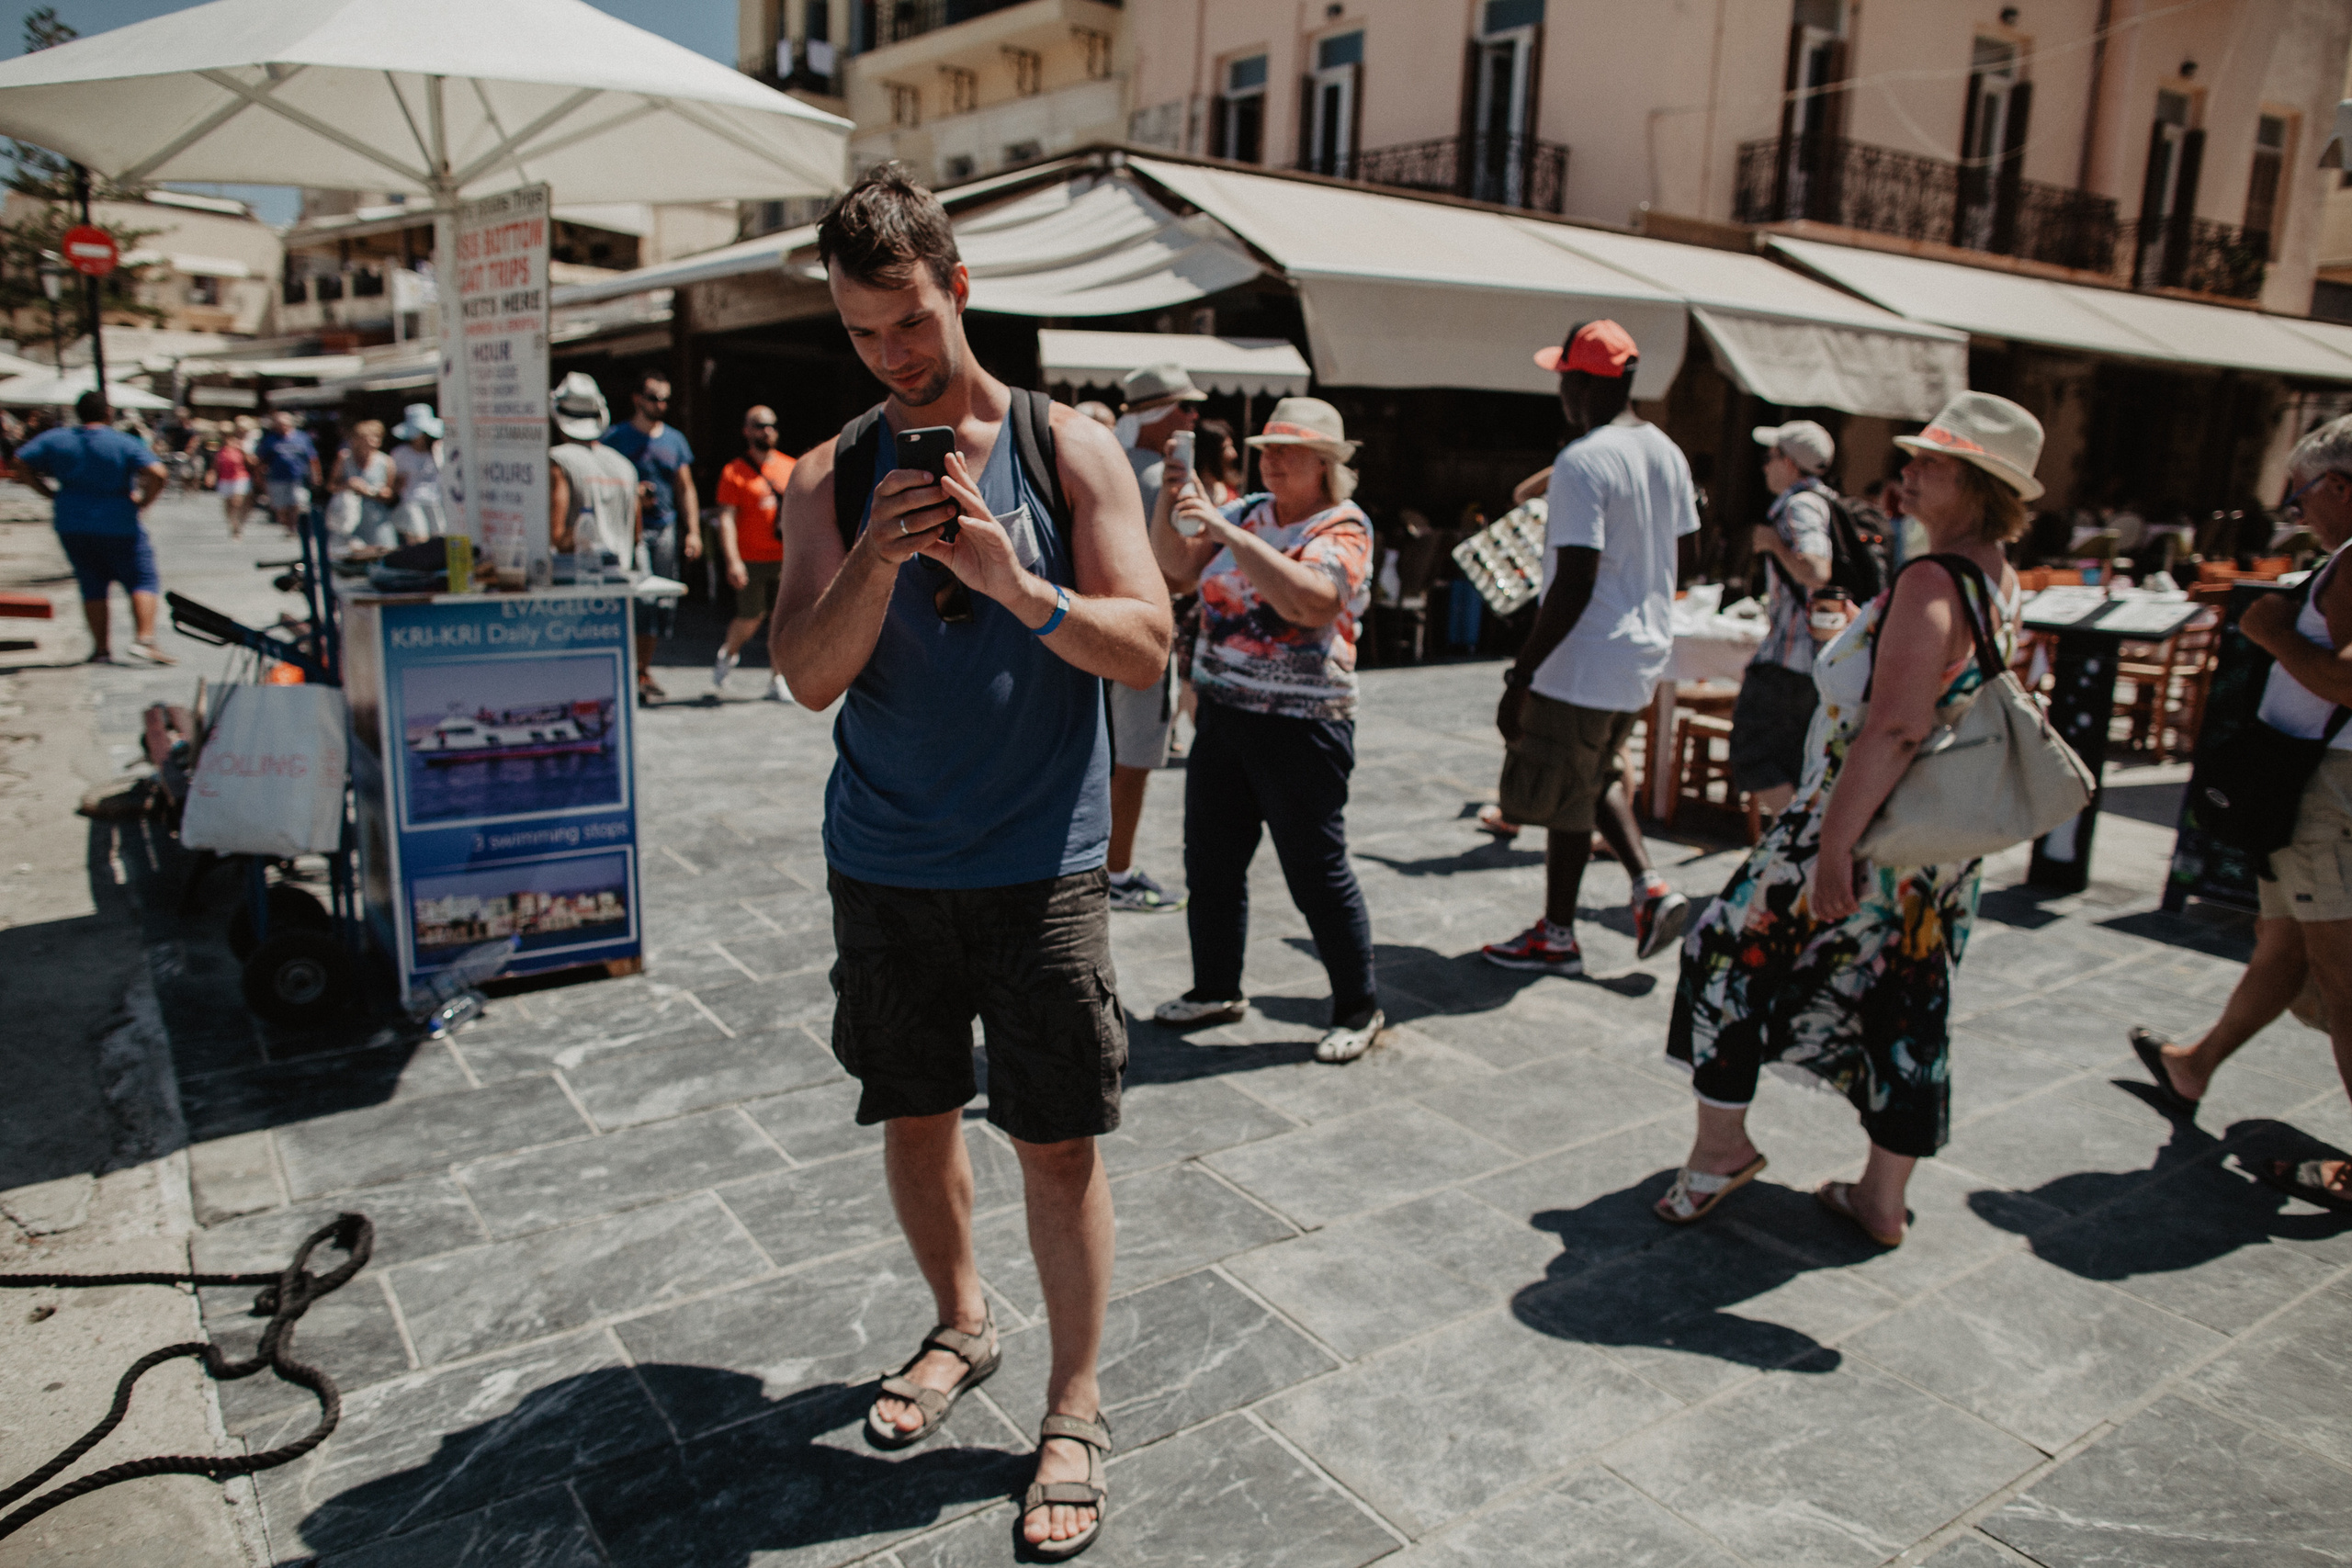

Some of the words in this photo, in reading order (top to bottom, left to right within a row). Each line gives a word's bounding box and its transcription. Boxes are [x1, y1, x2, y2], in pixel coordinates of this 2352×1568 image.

[484, 218, 543, 255] BOTTOM
[488, 255, 529, 288] TRIPS
[502, 289, 540, 313] HERE
[473, 339, 511, 363] HOUR
[480, 461, 534, 485] HOURS
[502, 600, 621, 618] EVAGELOS
[390, 625, 481, 649] KRI-KRI
[487, 621, 540, 647] Daily
[545, 619, 621, 642] Cruises
[488, 828, 580, 852] swimming
[582, 821, 629, 840] stops
